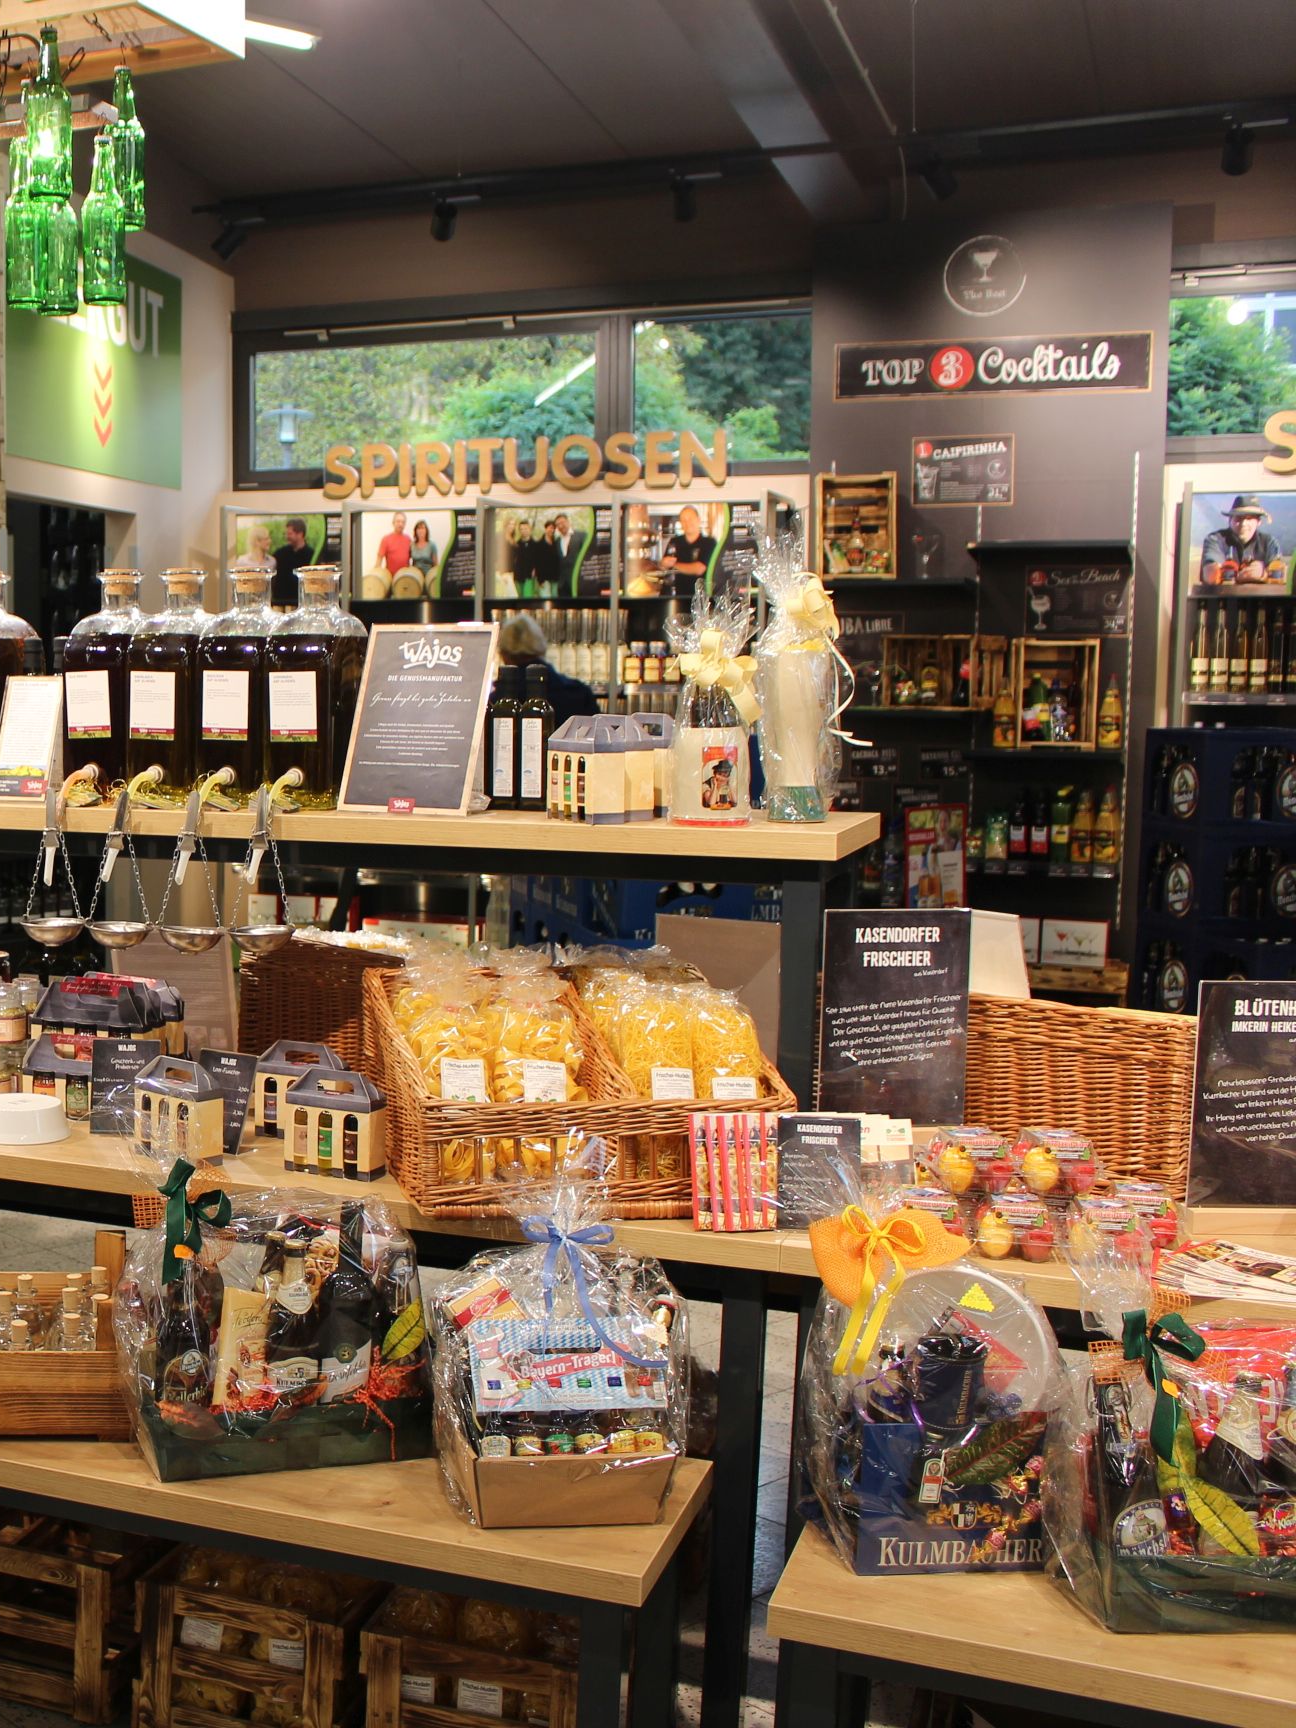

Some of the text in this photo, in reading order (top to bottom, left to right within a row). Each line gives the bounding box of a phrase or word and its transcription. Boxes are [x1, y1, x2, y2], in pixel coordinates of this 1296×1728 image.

[861, 341, 1121, 387] TOP 3 Cocktails
[933, 441, 1007, 460] CAIPIRINHA
[323, 430, 728, 499] SPIRITUOSEN
[387, 674, 398, 682] DIE
[855, 927, 940, 943] KASENDORFER
[863, 951, 931, 967] FRISCHEIER
[897, 997, 932, 1007] Kasendorfer
[833, 1027, 846, 1036] Der
[1232, 1021, 1296, 1033] IMKERIN HEIKE
[797, 1124, 843, 1134] KASENDORFER
[801, 1136, 838, 1145] FRISCHEIER
